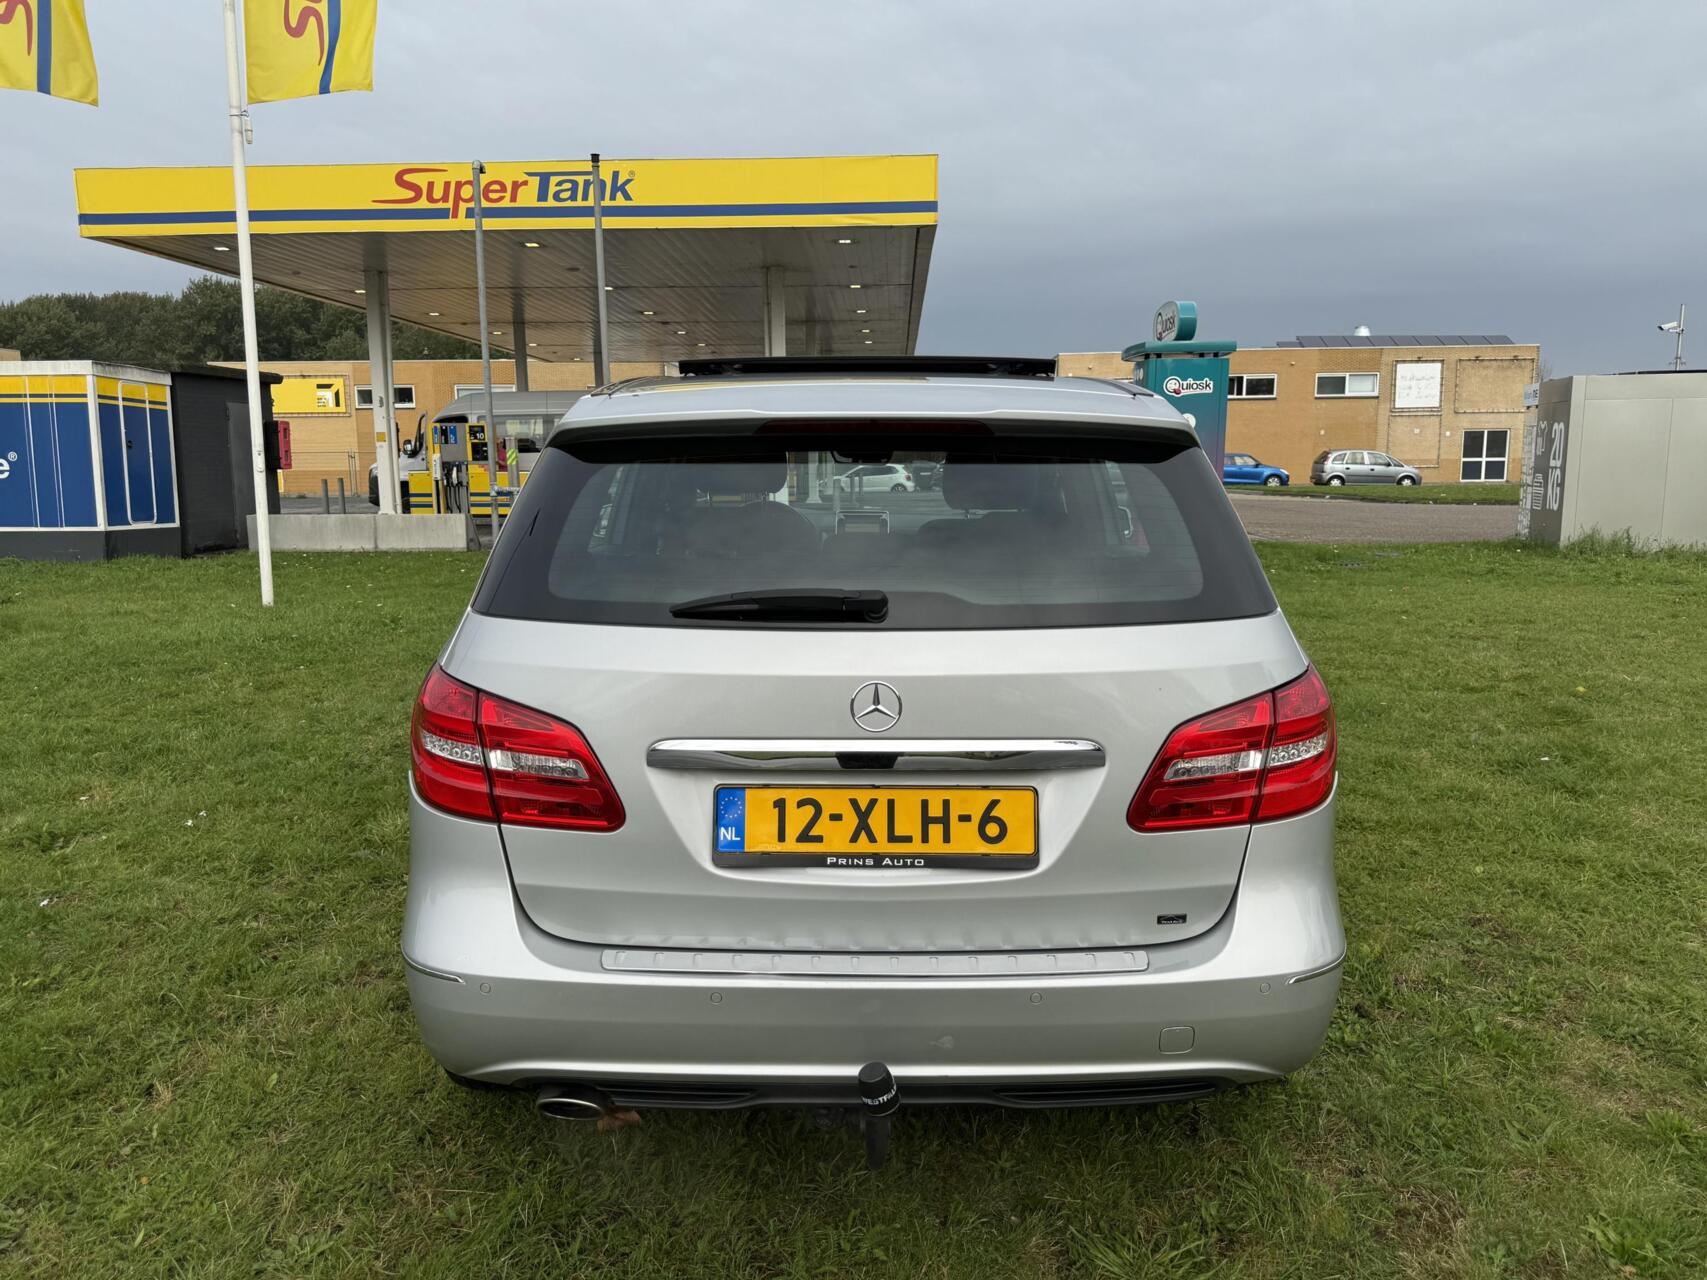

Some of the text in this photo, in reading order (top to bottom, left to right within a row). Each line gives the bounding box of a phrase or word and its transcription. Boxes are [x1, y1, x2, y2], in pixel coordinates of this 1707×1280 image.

[1156, 310, 1176, 341] Quiosk
[1165, 377, 1212, 394] Quiosk
[1549, 422, 1565, 468] 20
[1546, 468, 1561, 511] KG
[720, 827, 741, 841] NL
[772, 797, 1008, 844] 12-XLH-6
[827, 856, 925, 866] PRINS AUTO
